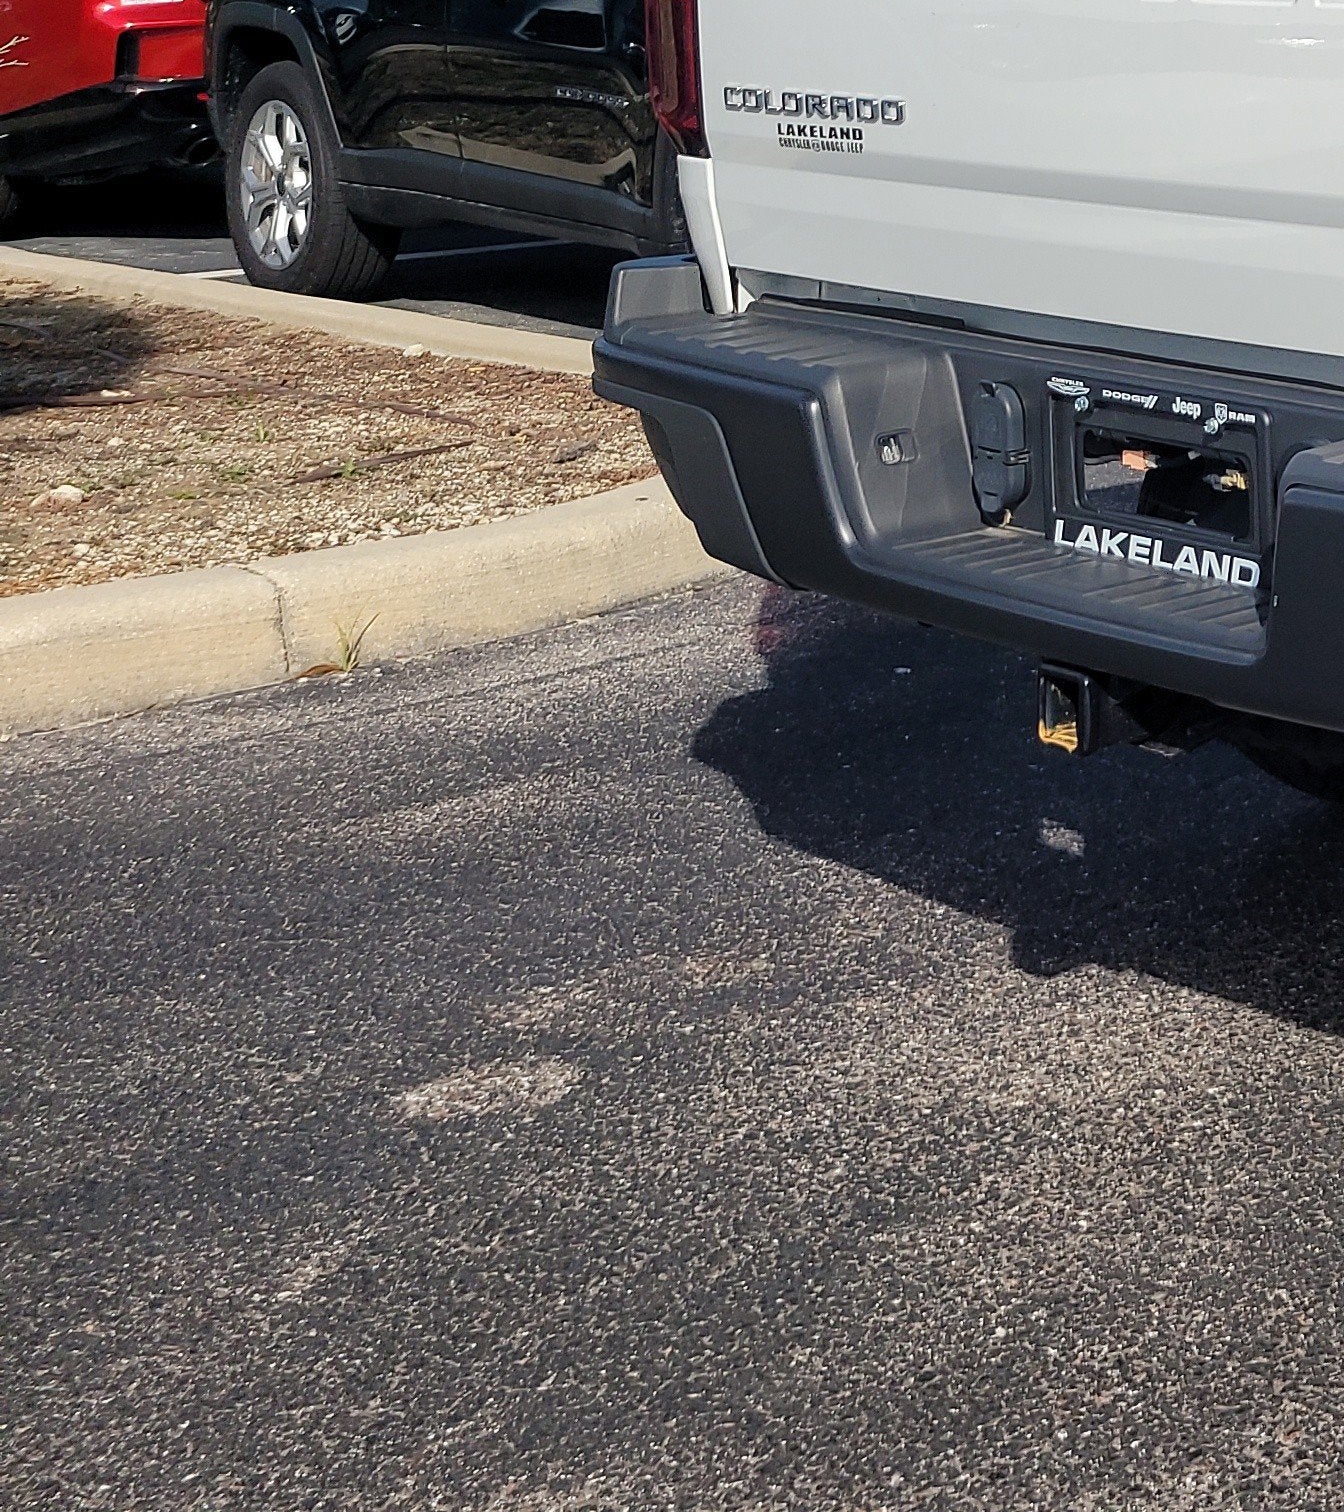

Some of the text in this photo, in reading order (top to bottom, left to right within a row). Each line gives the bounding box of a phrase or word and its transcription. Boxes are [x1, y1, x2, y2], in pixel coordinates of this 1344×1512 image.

[723, 86, 908, 126] COLORADO
[776, 122, 864, 141] LAKELAND
[1102, 389, 1153, 406] DODGE
[1172, 396, 1202, 420] Jeep
[1228, 410, 1257, 424] RAM
[1053, 519, 1261, 588] LAKELAND
